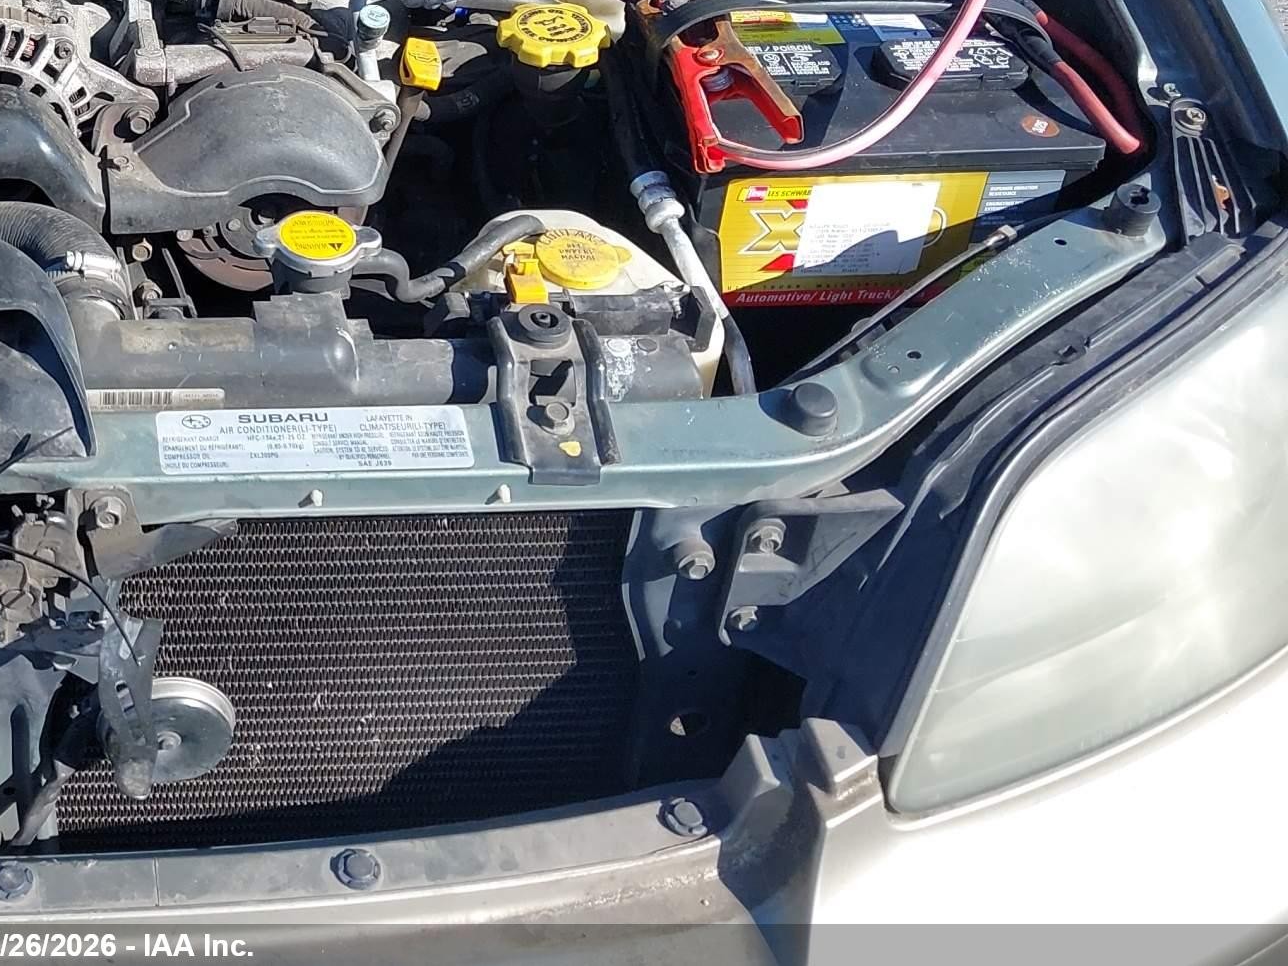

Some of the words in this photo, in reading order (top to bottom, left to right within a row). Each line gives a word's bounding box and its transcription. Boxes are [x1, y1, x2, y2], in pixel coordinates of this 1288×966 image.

[736, 292, 816, 304] Automotive/
[819, 291, 853, 303] Light
[857, 289, 899, 300] Truck/
[238, 412, 329, 424] SUBARU
[219, 426, 234, 434] AIR
[237, 424, 337, 434] CONDITIONER(LI-TYPE)
